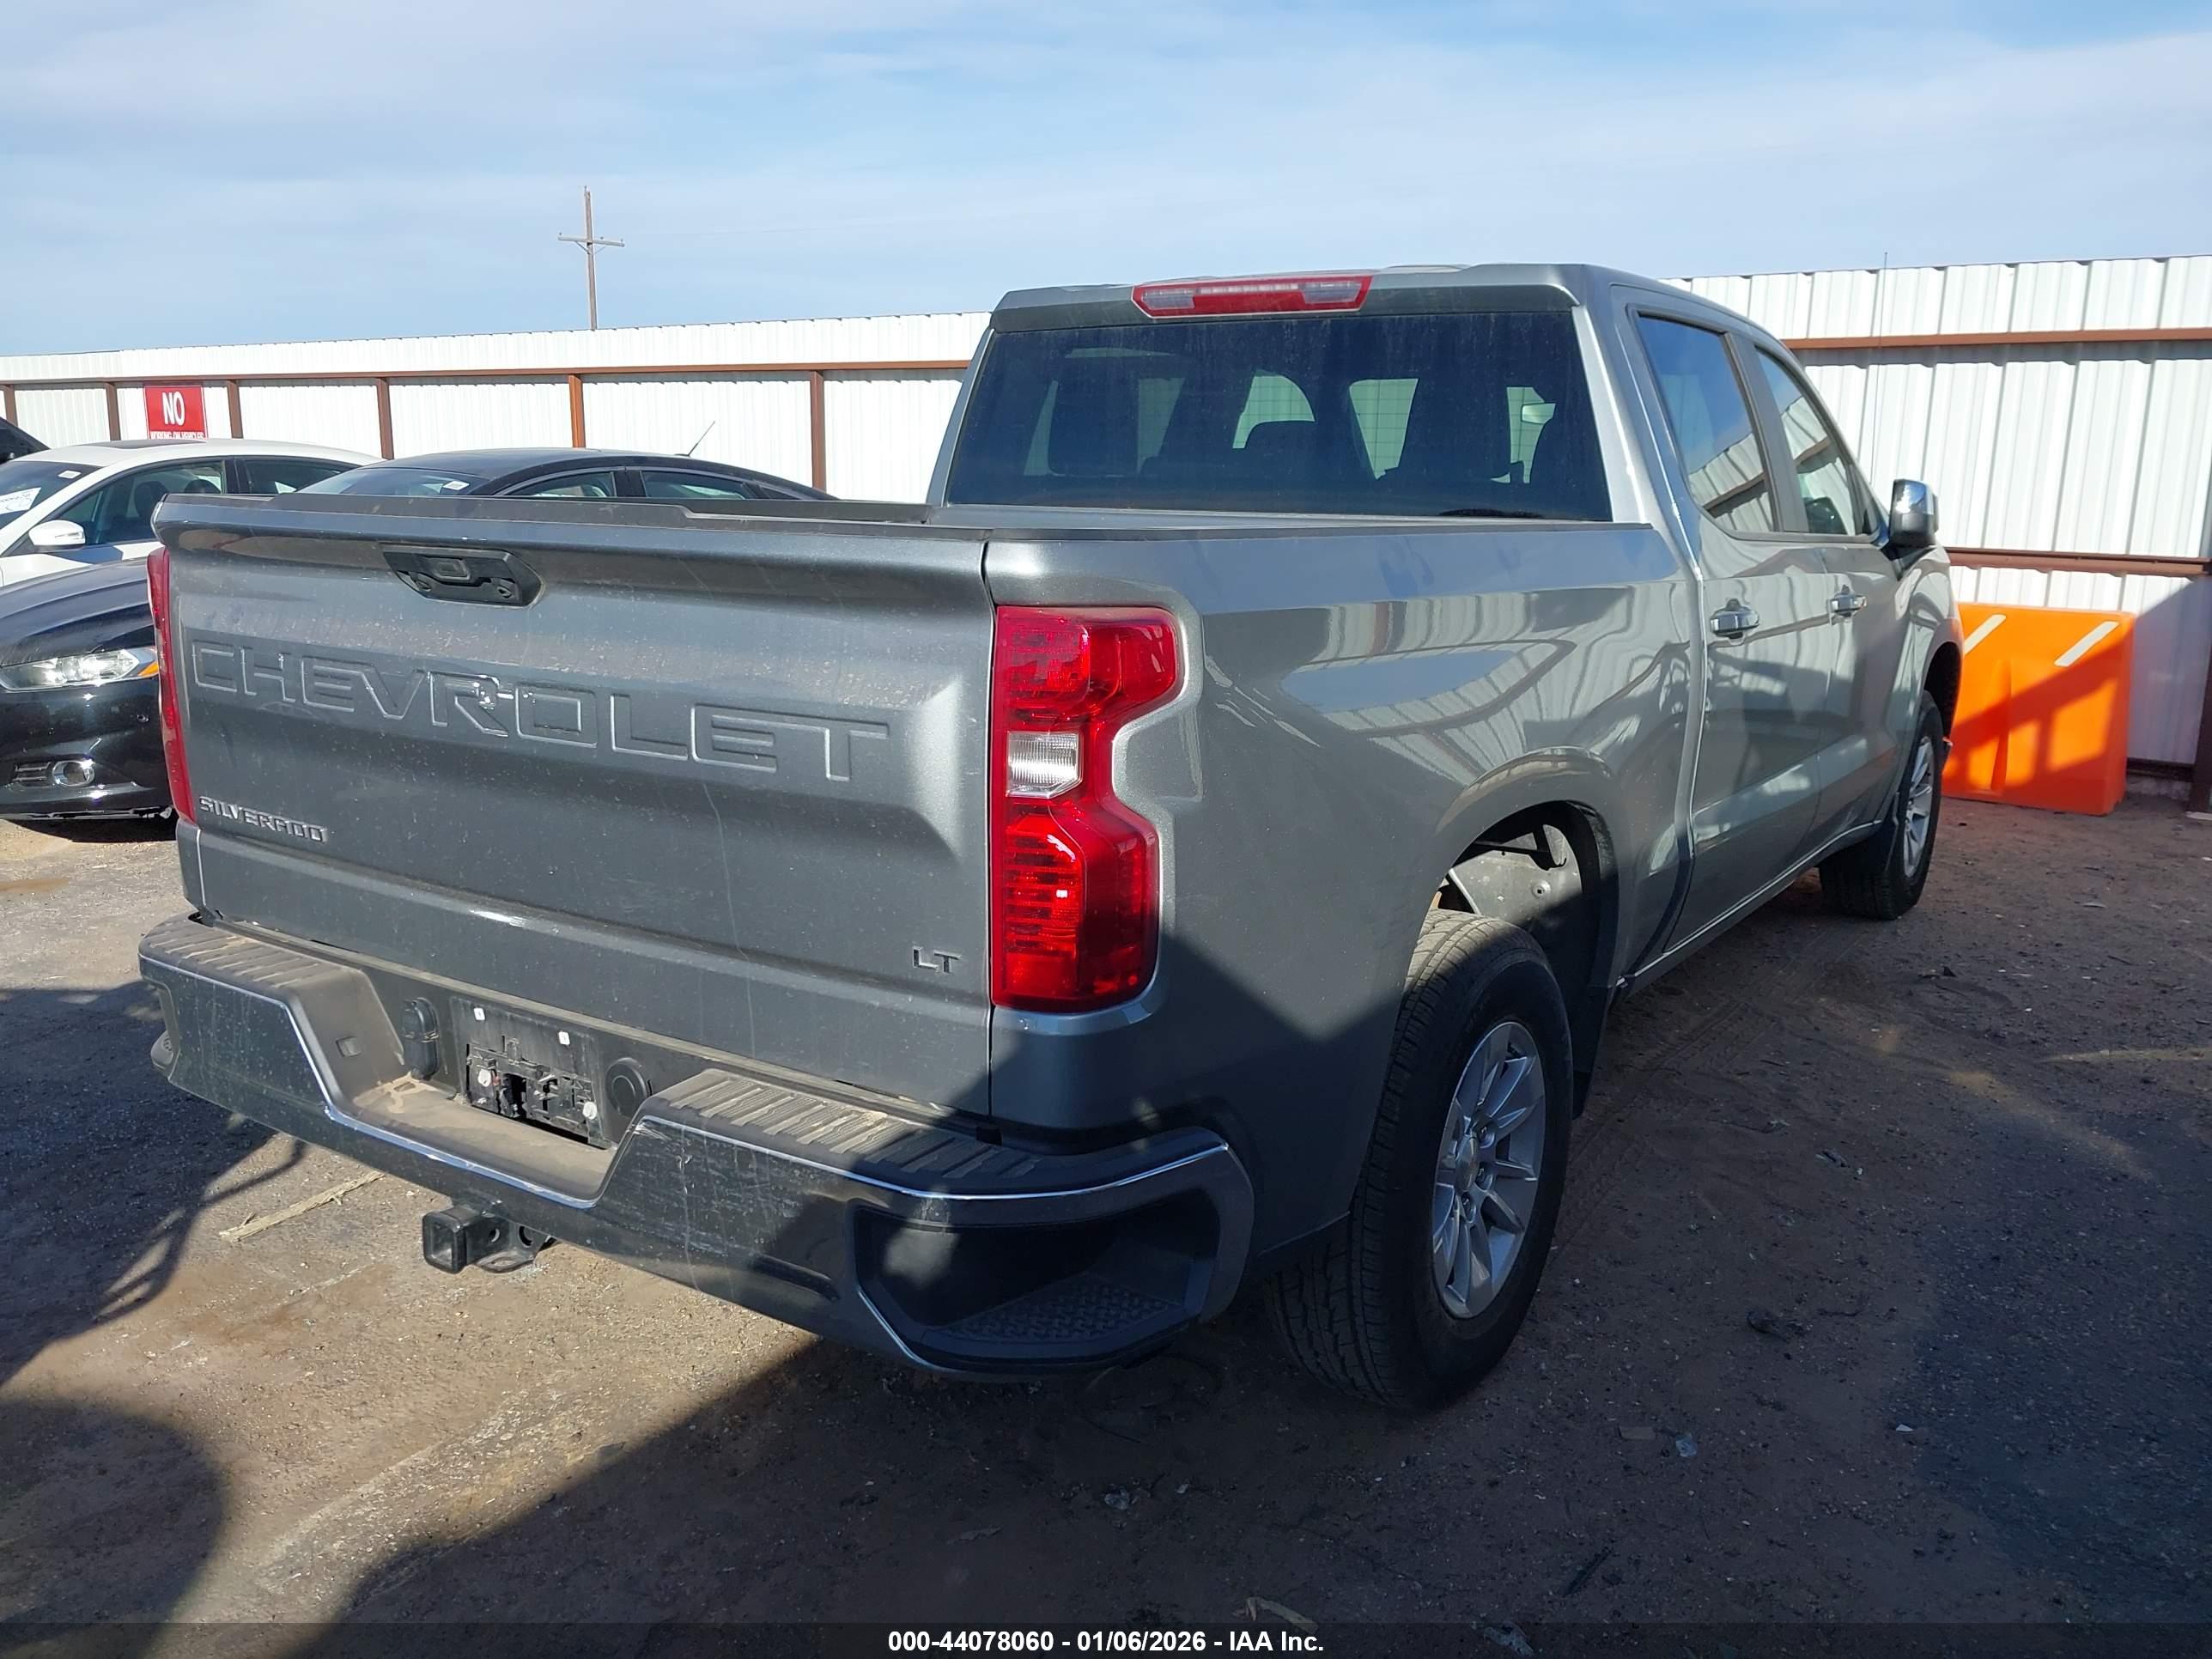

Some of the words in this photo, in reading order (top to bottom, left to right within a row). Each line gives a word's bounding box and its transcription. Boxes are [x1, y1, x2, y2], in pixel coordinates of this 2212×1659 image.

[161, 391, 185, 426] NO
[191, 639, 890, 782] CHEVROLET
[199, 795, 328, 842] SILVERADO
[912, 945, 962, 975] LT
